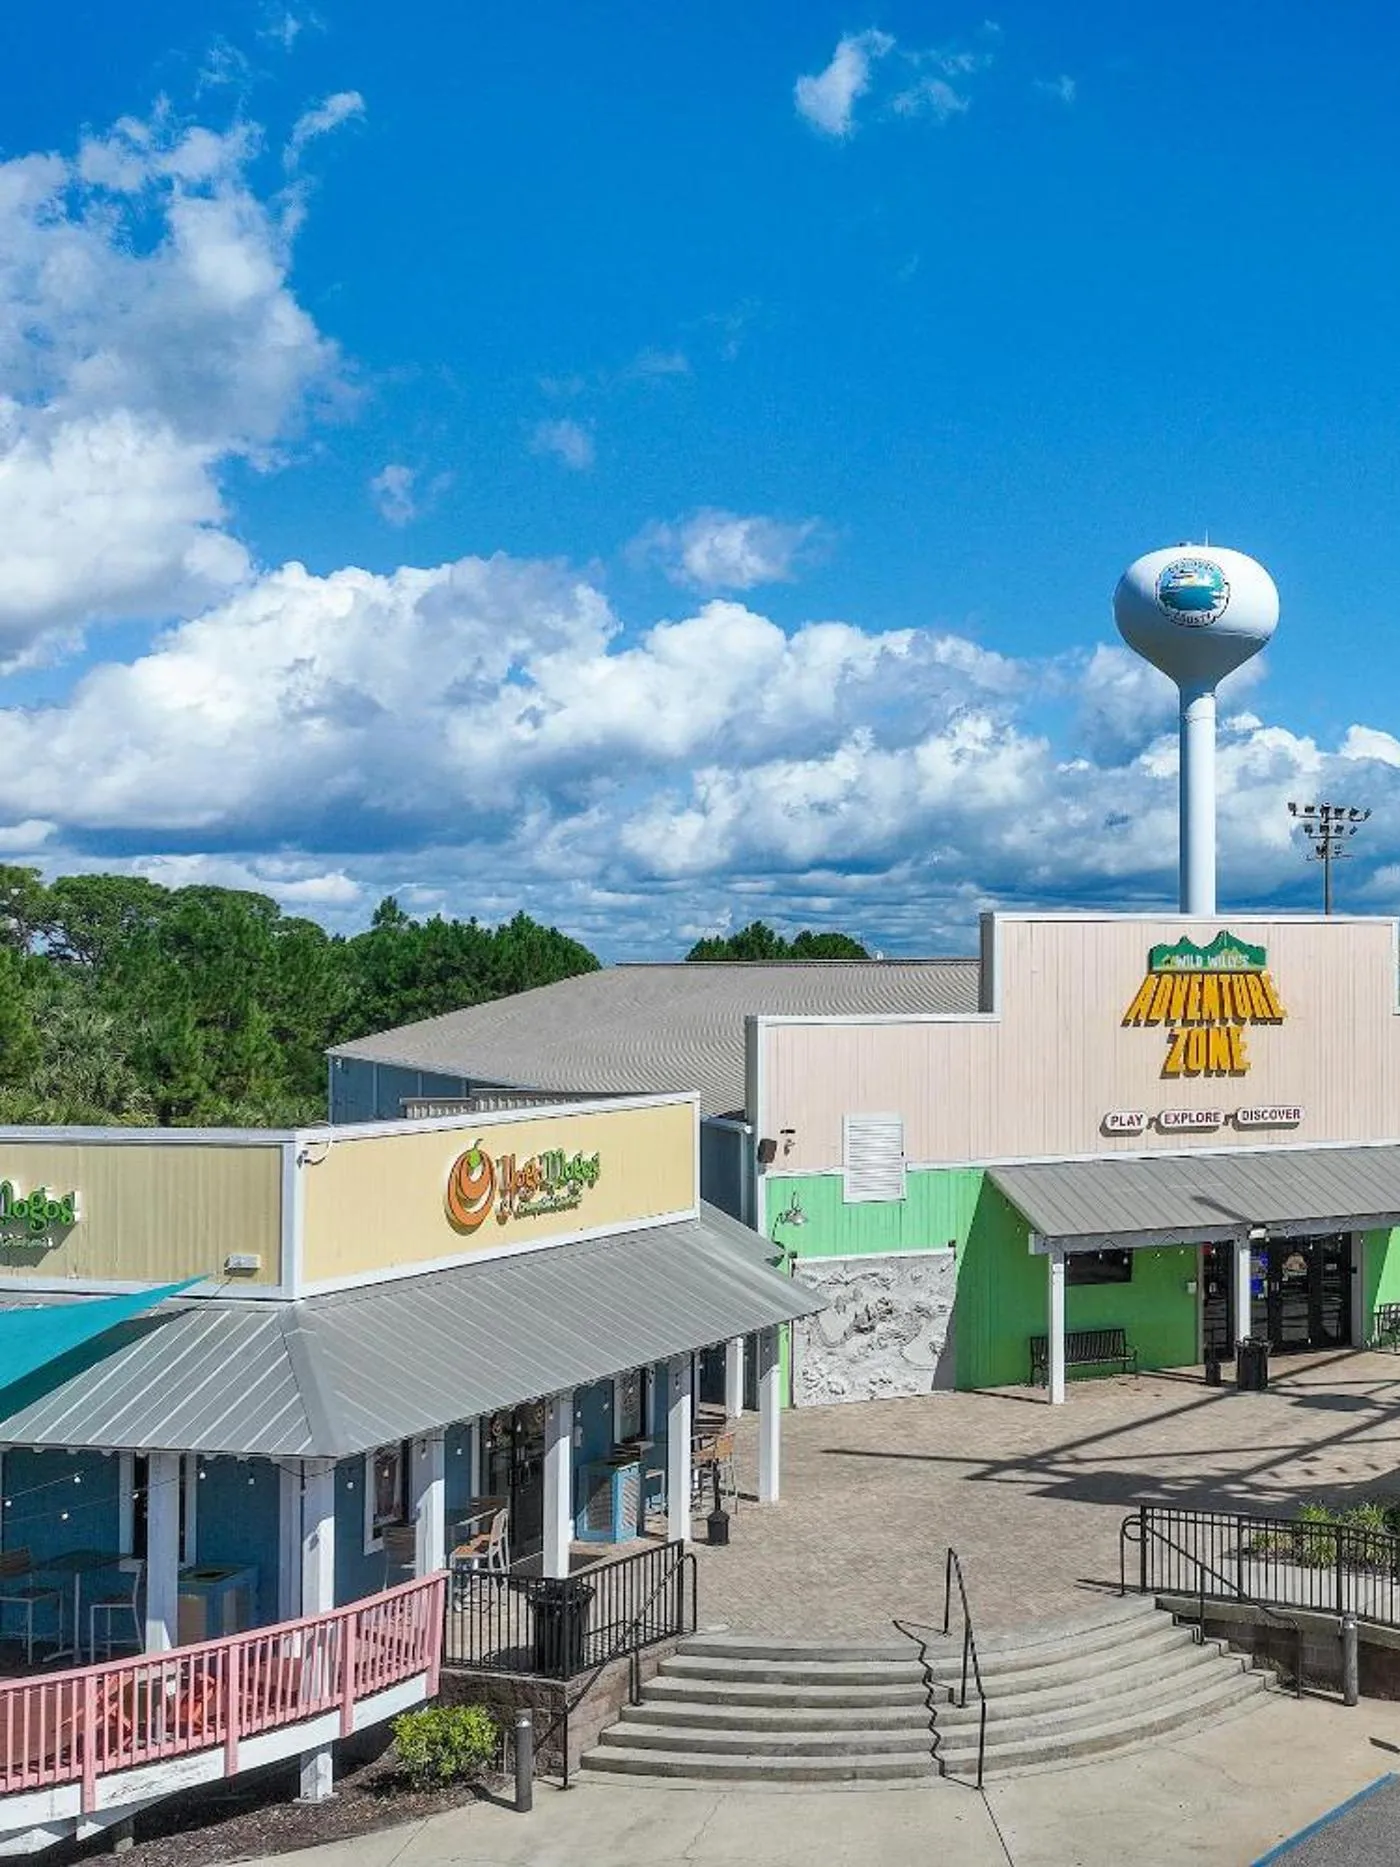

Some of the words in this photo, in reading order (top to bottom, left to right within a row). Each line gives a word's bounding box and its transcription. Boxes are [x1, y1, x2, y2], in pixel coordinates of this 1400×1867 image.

[1122, 972, 1287, 1025] ADVENTURE
[1162, 1026, 1251, 1077] ZONE
[1109, 1113, 1144, 1127] PLAY
[1164, 1111, 1221, 1125] EXPLORE
[1240, 1108, 1301, 1121] DISCOVER
